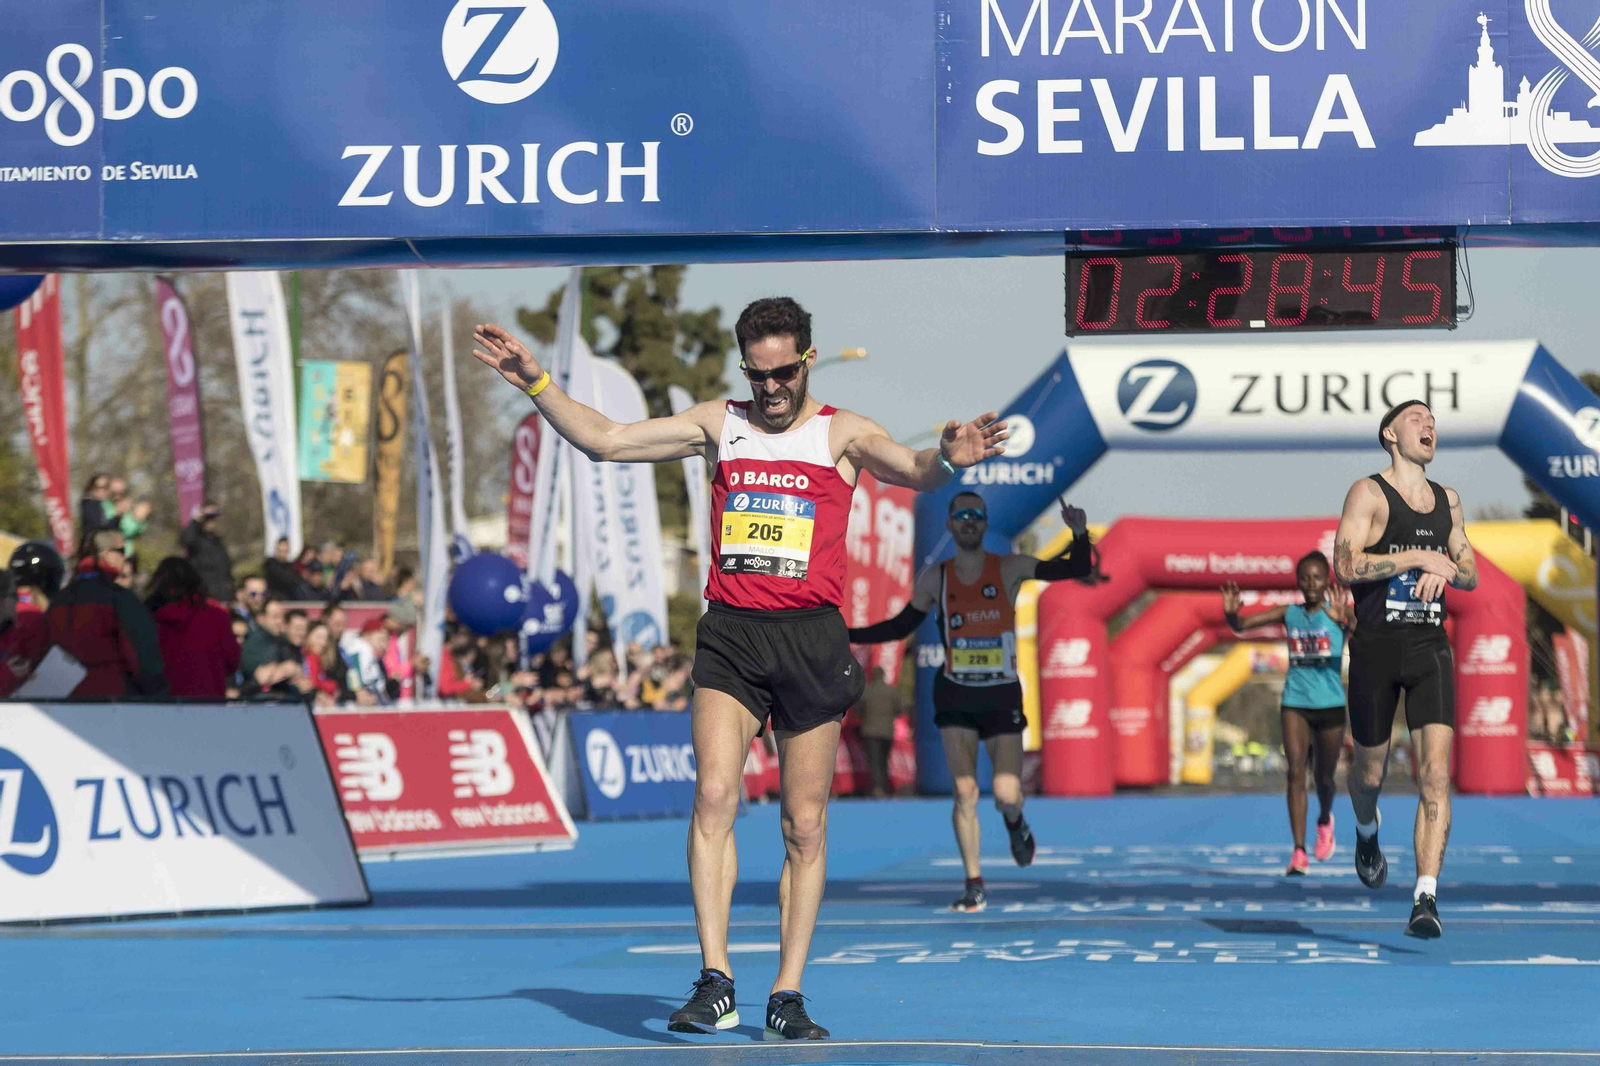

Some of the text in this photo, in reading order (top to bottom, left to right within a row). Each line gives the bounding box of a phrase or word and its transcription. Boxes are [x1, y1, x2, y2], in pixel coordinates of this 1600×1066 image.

[975, 74, 1377, 156] SEVILLA
[0, 165, 92, 182] TAMIENTO
[102, 165, 127, 181] DE
[337, 141, 662, 207] ZURICH
[1077, 250, 1443, 330] 02:28:45
[1230, 369, 1460, 415] ZURICH
[743, 471, 810, 490] BARCO
[961, 462, 1055, 486] ZURICH
[751, 497, 804, 514] ZURICH
[747, 522, 783, 542] 205
[1165, 551, 1293, 574] new balance
[966, 609, 1000, 622] TEAM
[75, 773, 296, 840] ZURICH
